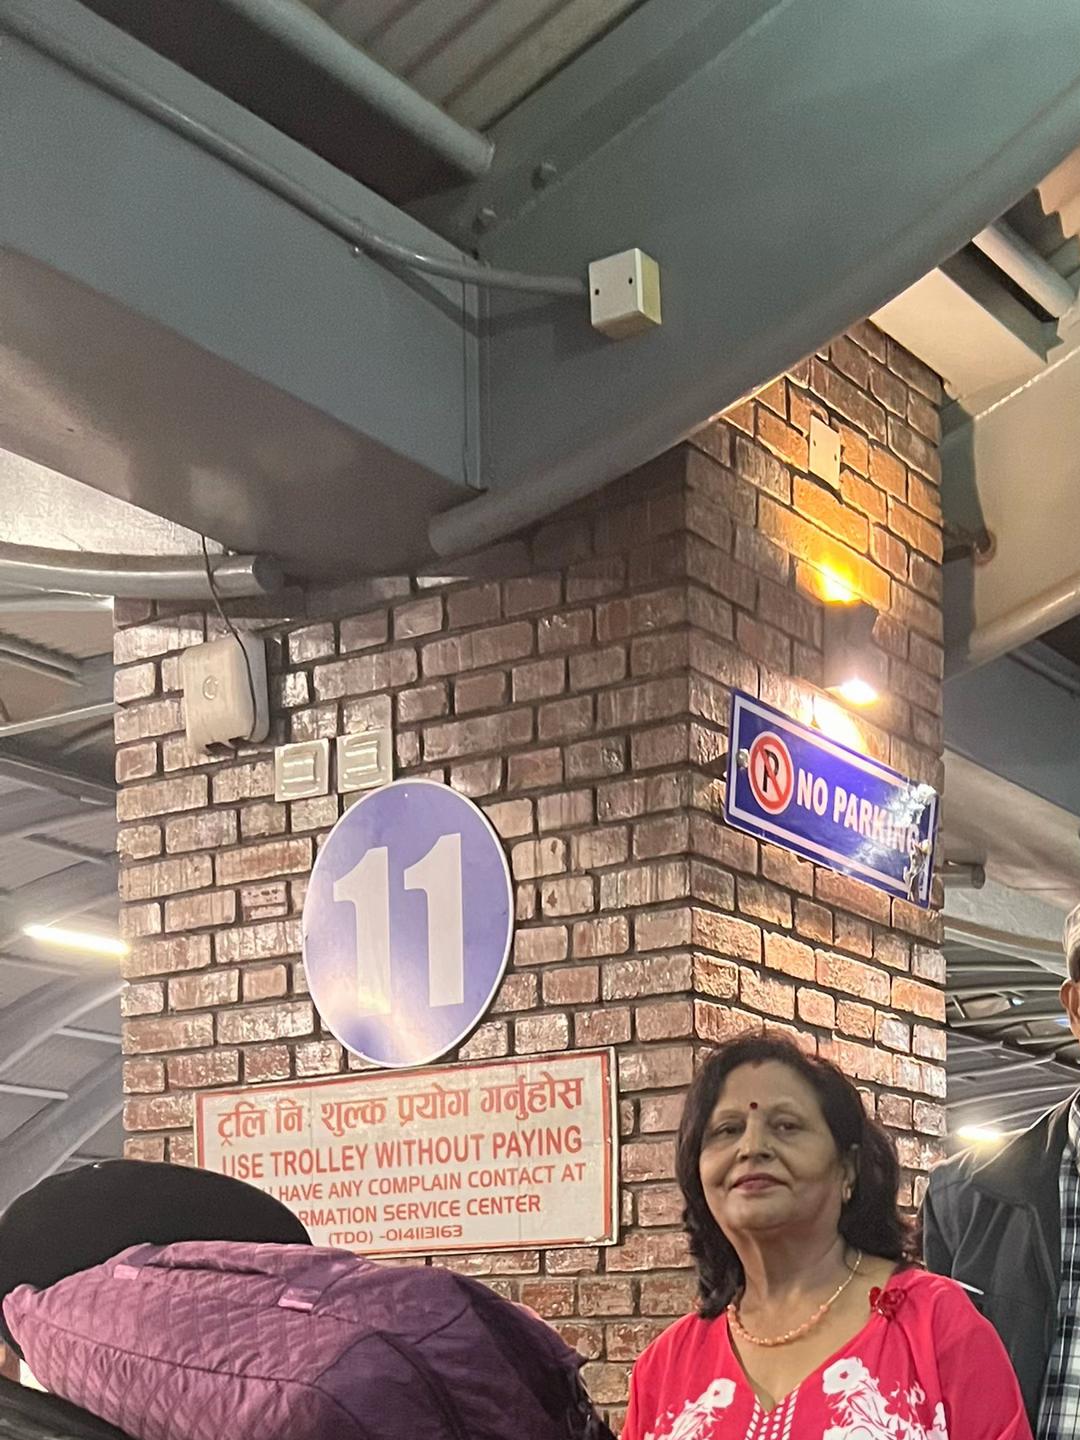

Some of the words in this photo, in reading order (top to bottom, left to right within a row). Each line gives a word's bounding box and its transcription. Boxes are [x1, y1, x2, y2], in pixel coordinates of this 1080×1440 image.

[797, 768, 828, 816] NO
[333, 833, 465, 1017] 11
[396, 1082, 471, 1127] प्रयोग
[222, 1152, 264, 1180] USE
[270, 1142, 369, 1178] TROLLEY
[375, 1133, 485, 1169] WITHOUT
[492, 1125, 583, 1160] PAYING
[279, 1182, 323, 1202] HAVE
[328, 1180, 364, 1199] ANY
[368, 1172, 462, 1195] COMPLAIN
[468, 1165, 556, 1189] CONTACT
[561, 1163, 587, 1183] AT
[298, 1206, 377, 1227] RMATION
[383, 1200, 462, 1222] SERVICE
[466, 1194, 541, 1216] CENTER
[328, 1229, 374, 1247] (TDO)
